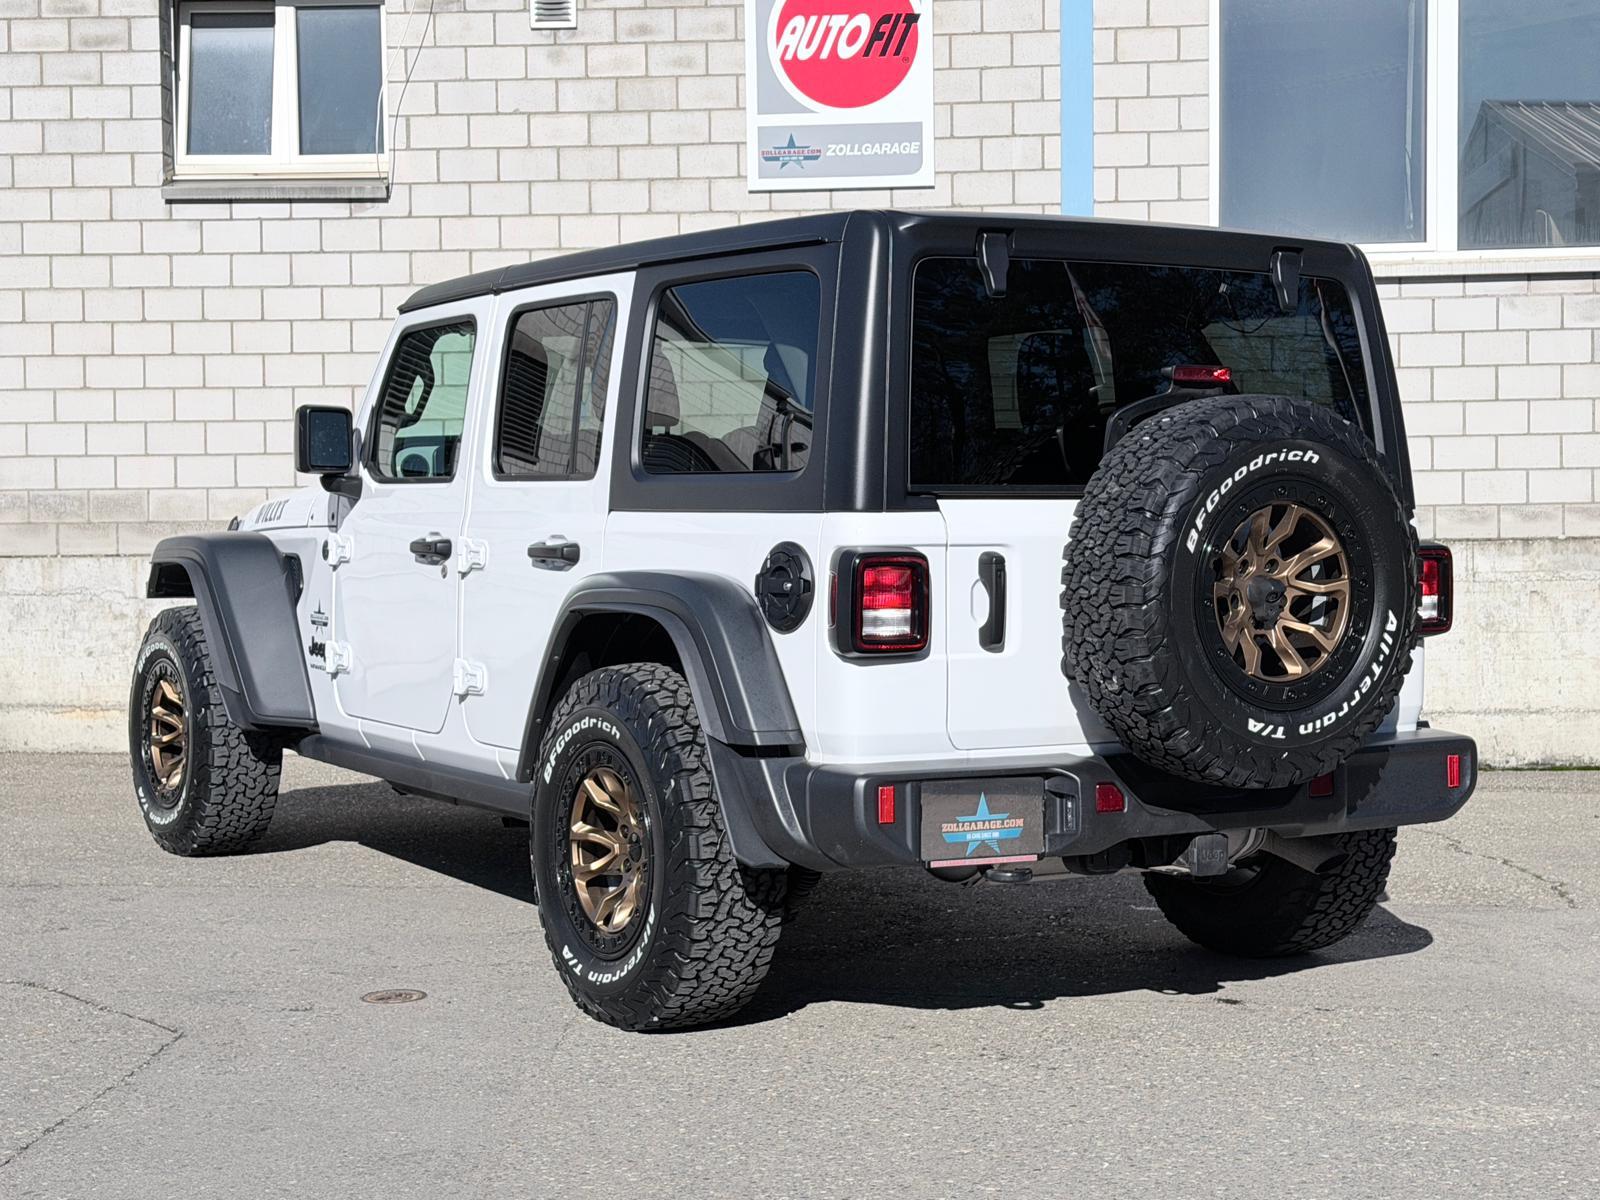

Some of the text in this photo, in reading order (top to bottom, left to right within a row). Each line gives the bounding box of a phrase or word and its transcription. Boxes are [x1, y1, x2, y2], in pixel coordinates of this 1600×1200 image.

[826, 141, 920, 156] ZOLLGARAGE
[1186, 448, 1320, 554] BFGoodrich
[1247, 610, 1398, 739] All-Terrain T/A
[543, 716, 621, 785] BFGoodrich
[941, 818, 1025, 833] ZOLLGARAGE.COM
[562, 902, 655, 986] All-Terrain T/A
